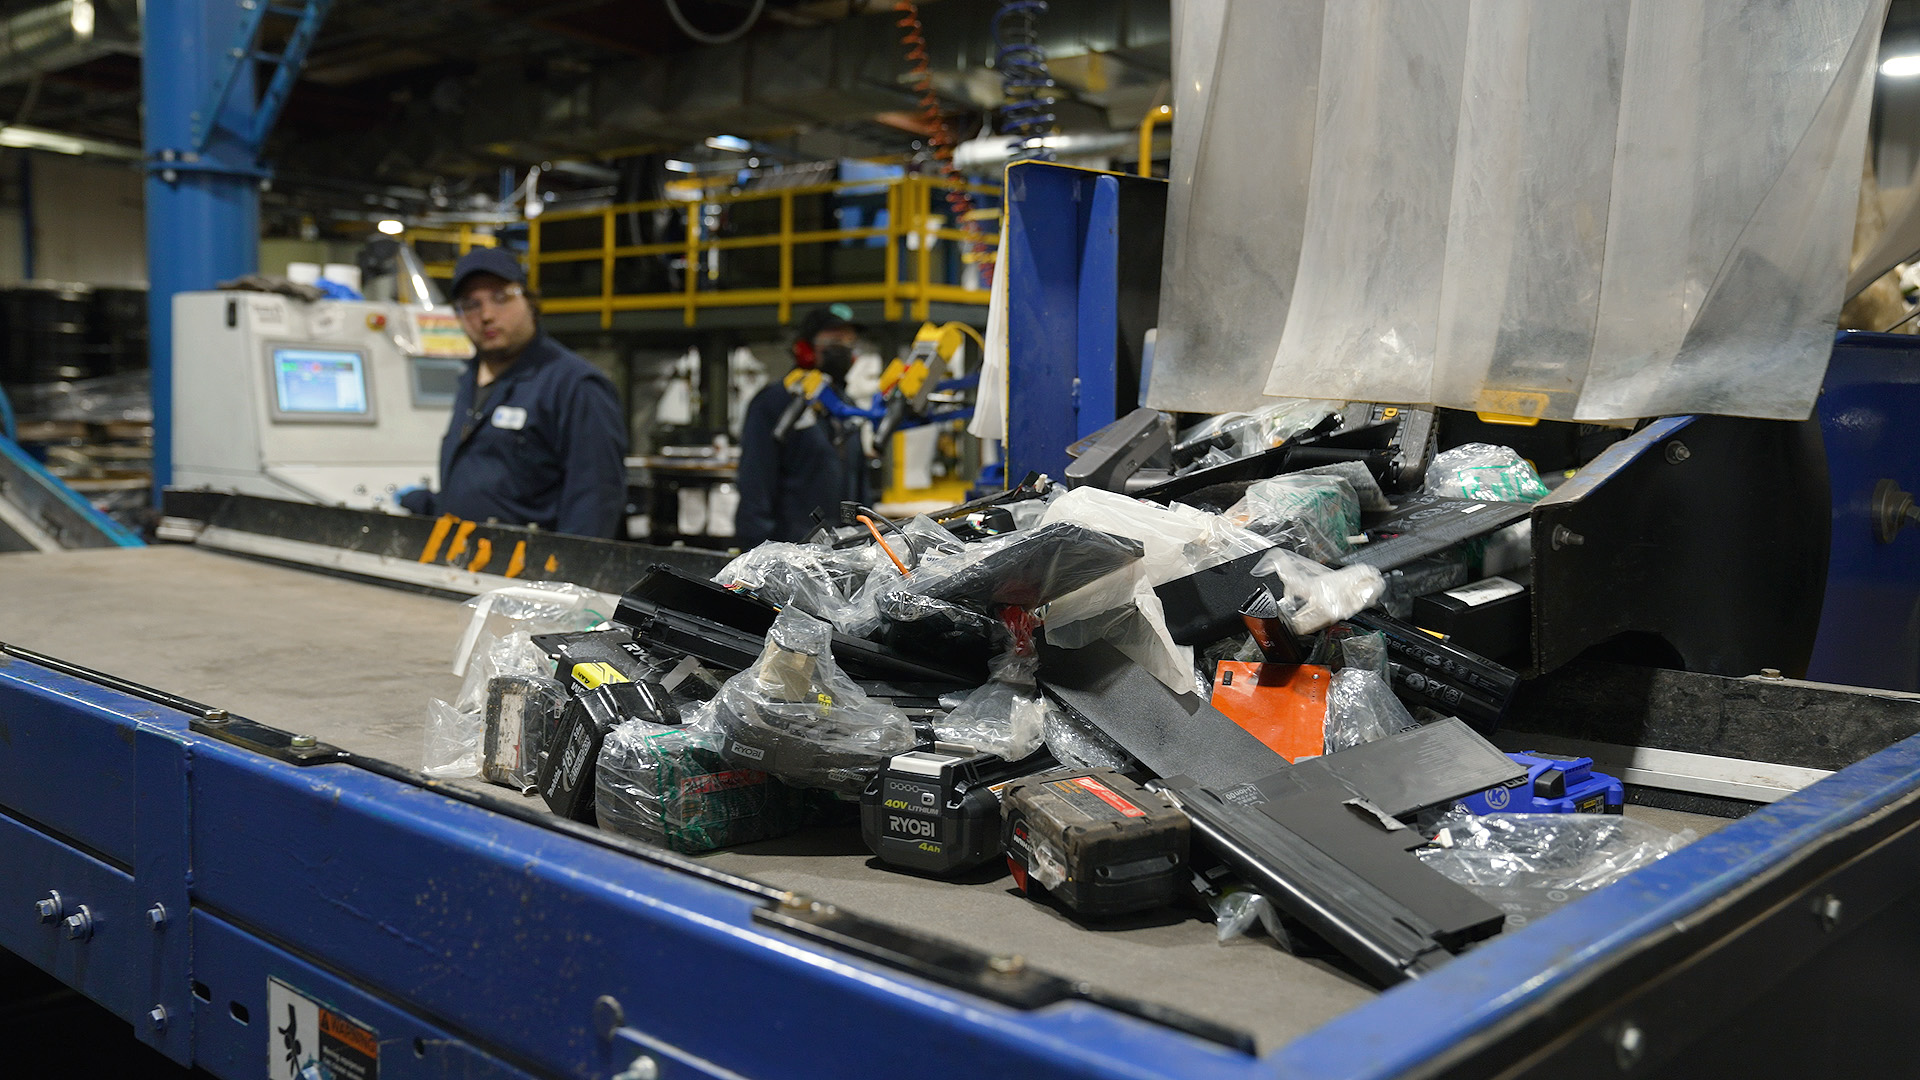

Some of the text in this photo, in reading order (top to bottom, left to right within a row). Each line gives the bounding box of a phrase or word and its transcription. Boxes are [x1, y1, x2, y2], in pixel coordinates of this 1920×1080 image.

[733, 743, 762, 758] RYOBI
[884, 799, 939, 815] 40V LITHIUM
[889, 815, 935, 837] RYOBI
[918, 842, 941, 853] 4Ah
